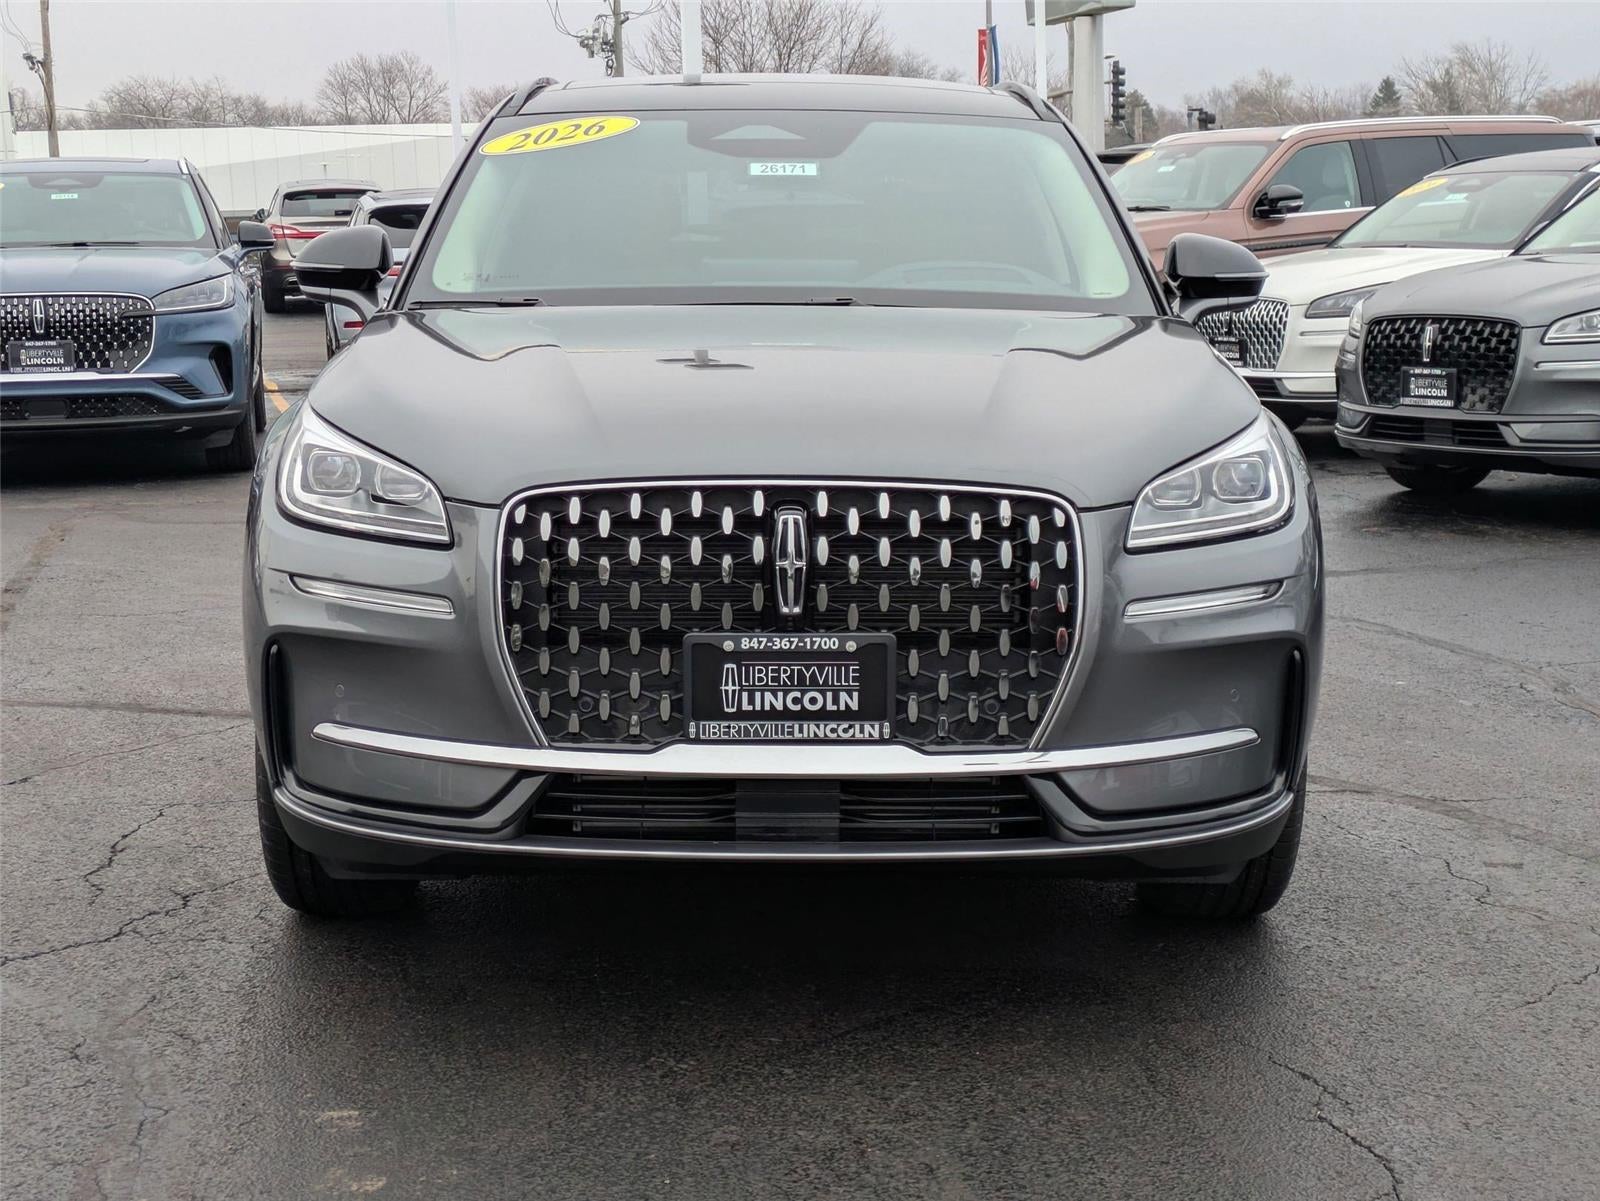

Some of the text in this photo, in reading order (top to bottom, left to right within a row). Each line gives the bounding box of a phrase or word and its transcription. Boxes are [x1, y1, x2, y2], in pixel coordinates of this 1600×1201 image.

[505, 119, 610, 151] 2026
[759, 163, 806, 174] 26171
[26, 357, 65, 365] LINCOLN
[1415, 387, 1448, 397] LINCOLN
[740, 637, 839, 650] 847-367-1700
[741, 665, 860, 686] LIBERTYVILLE
[741, 691, 859, 711] LINCOLN
